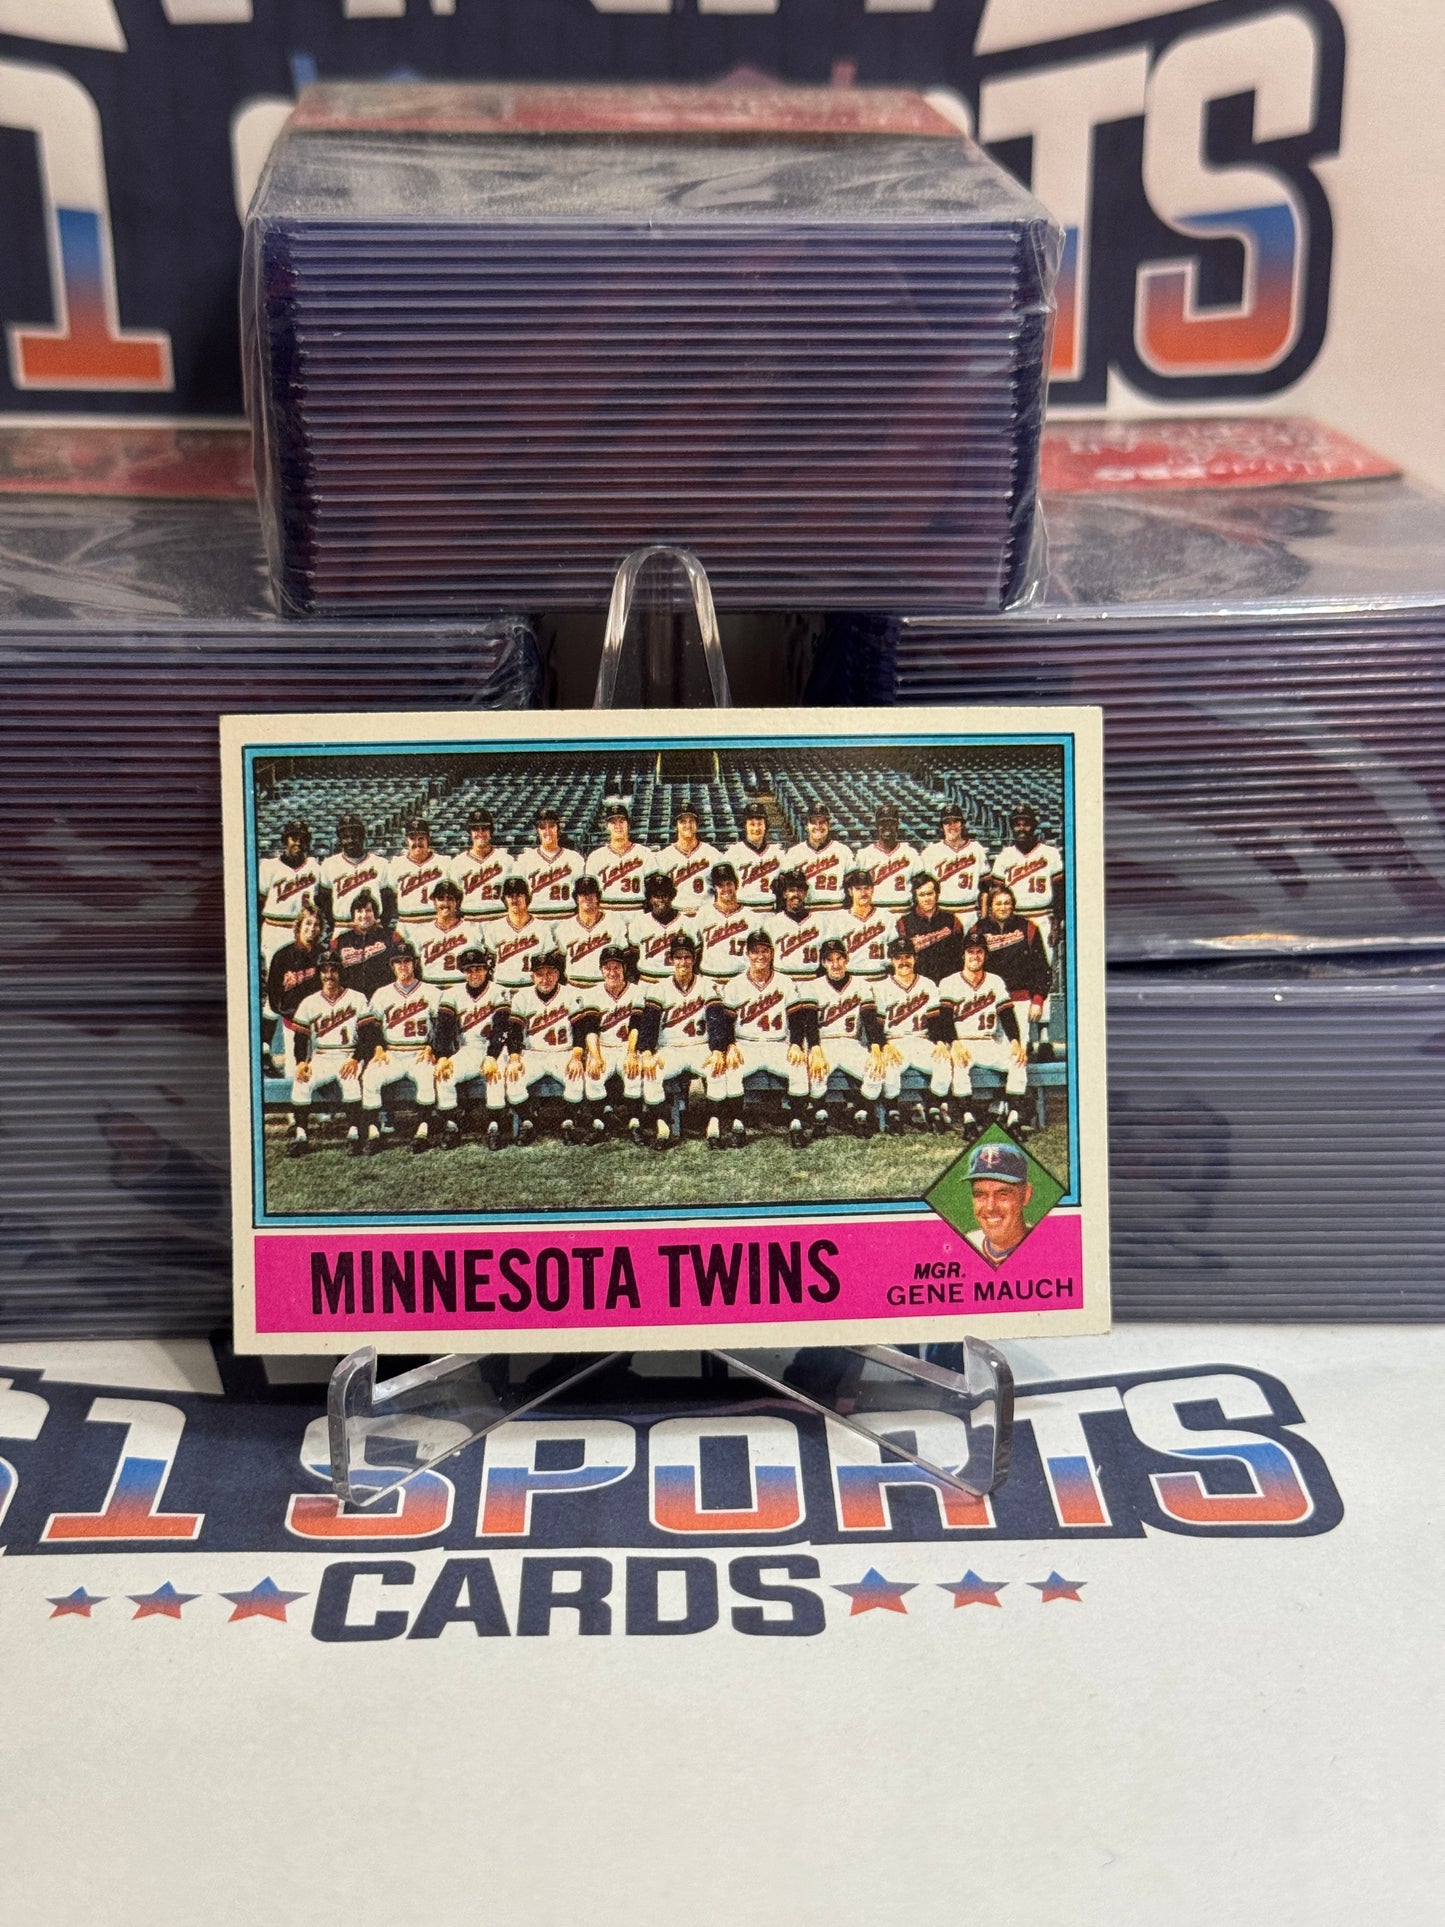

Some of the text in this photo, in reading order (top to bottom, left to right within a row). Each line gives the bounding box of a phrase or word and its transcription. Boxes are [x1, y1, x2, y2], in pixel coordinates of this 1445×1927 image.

[815, 875, 837, 891] 22
[1028, 876, 1047, 893] 15
[404, 1020, 428, 1038] 25
[978, 1012, 996, 1031] 19
[311, 1239, 841, 1315] MINNESOTA TWINS
[913, 1261, 966, 1280] MGR.
[886, 1277, 1074, 1307] GENE MAUCH
[284, 1373, 1316, 1541] SPORTS
[311, 1553, 827, 1643] CARDS
